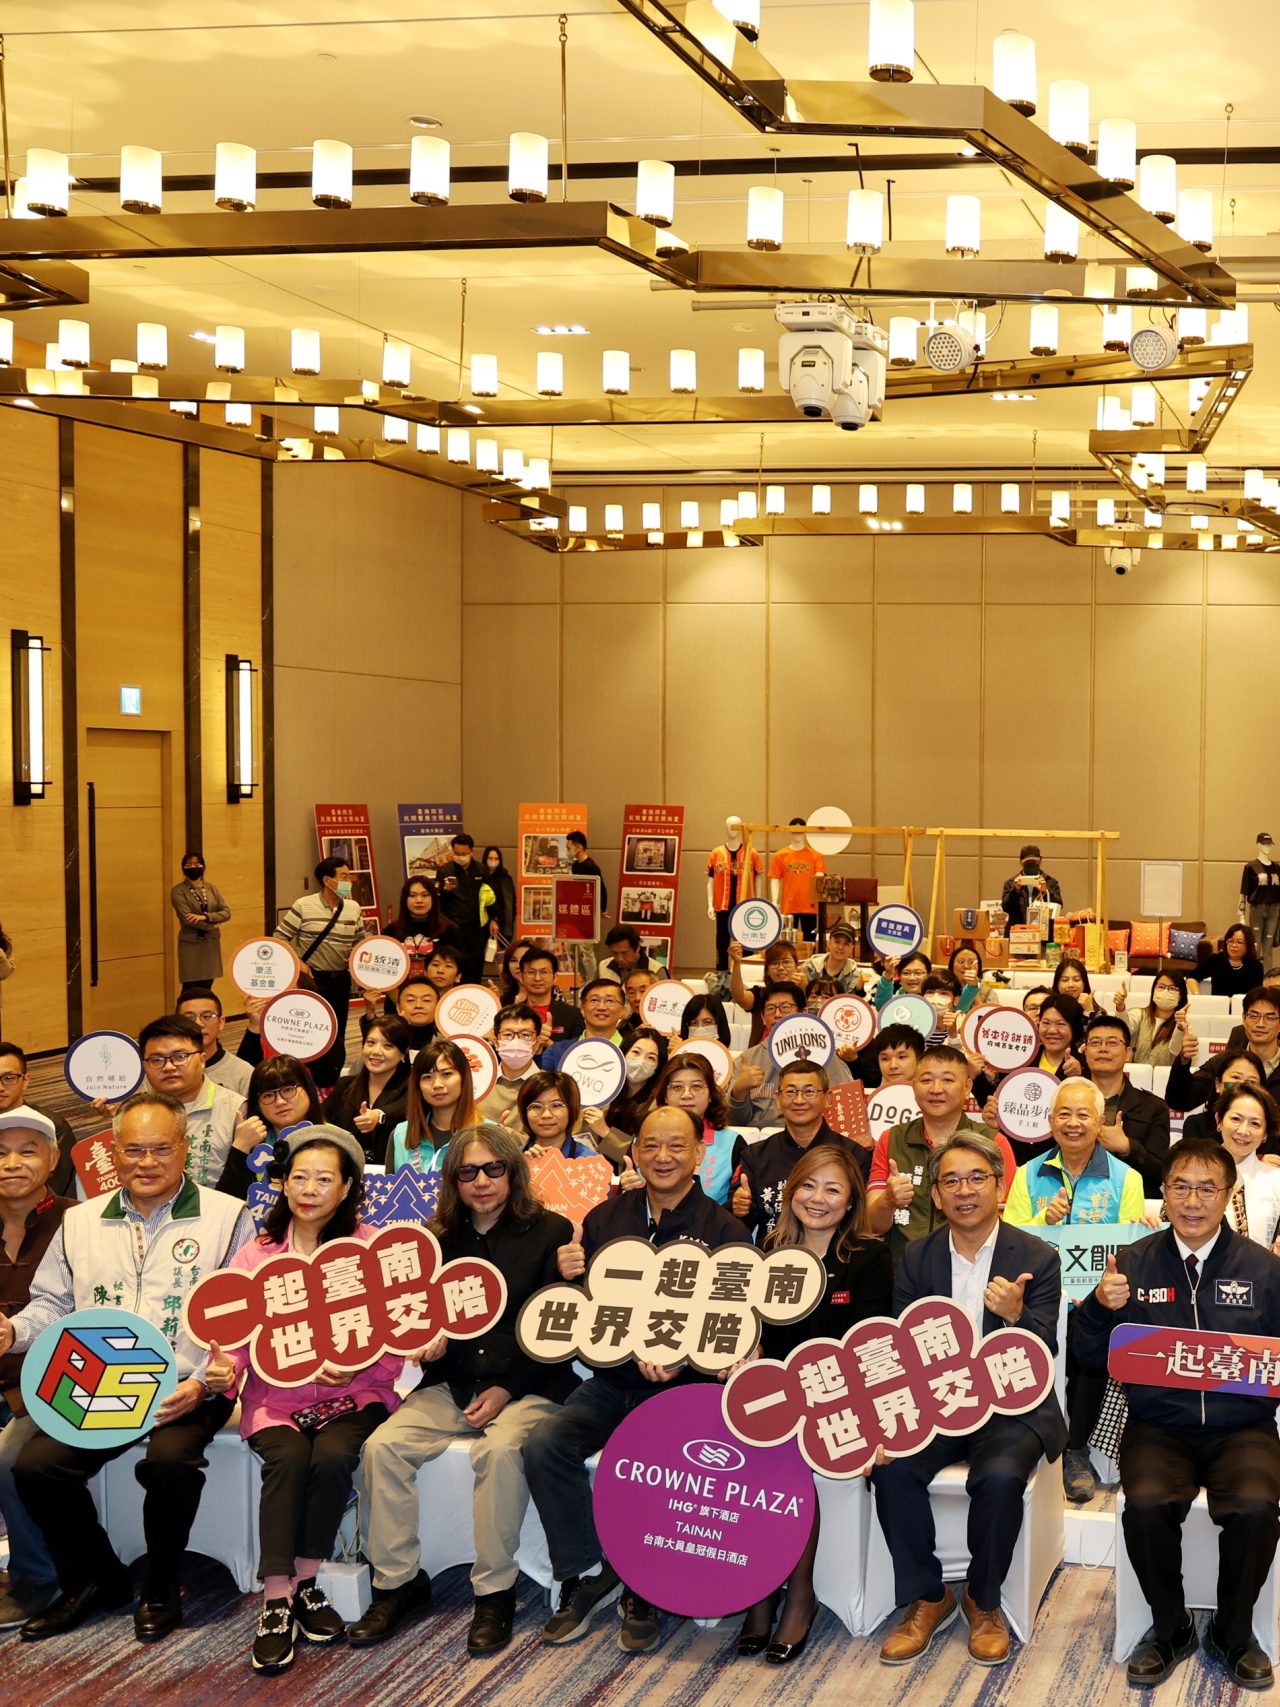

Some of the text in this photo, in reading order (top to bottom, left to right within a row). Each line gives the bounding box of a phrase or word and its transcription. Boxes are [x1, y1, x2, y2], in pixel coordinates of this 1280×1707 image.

[558, 904, 592, 916] 媒體區
[251, 979, 276, 988] 基金會
[256, 966, 273, 975] 樂活
[266, 1015, 301, 1027] CROWNE
[304, 1021, 330, 1031] PLAZA
[775, 1033, 827, 1056] UNILIONS
[203, 1240, 422, 1321] 一起臺南
[604, 1258, 809, 1304] 一起臺南
[1137, 1287, 1176, 1304] C-130H
[94, 1287, 111, 1306] 陳
[160, 1294, 182, 1351] 邱莉
[272, 1277, 489, 1371] 世界交陪
[535, 1300, 744, 1356] 世界交陪
[743, 1313, 962, 1418] 一起臺南
[816, 1345, 1037, 1463] 世界交陪
[615, 1458, 800, 1518] CROWNE PLAZA
[668, 1498, 740, 1524] IHG 旗下酒店
[676, 1521, 723, 1541] TAINAN
[643, 1533, 749, 1567] 台南大員皇冠假日酒店
